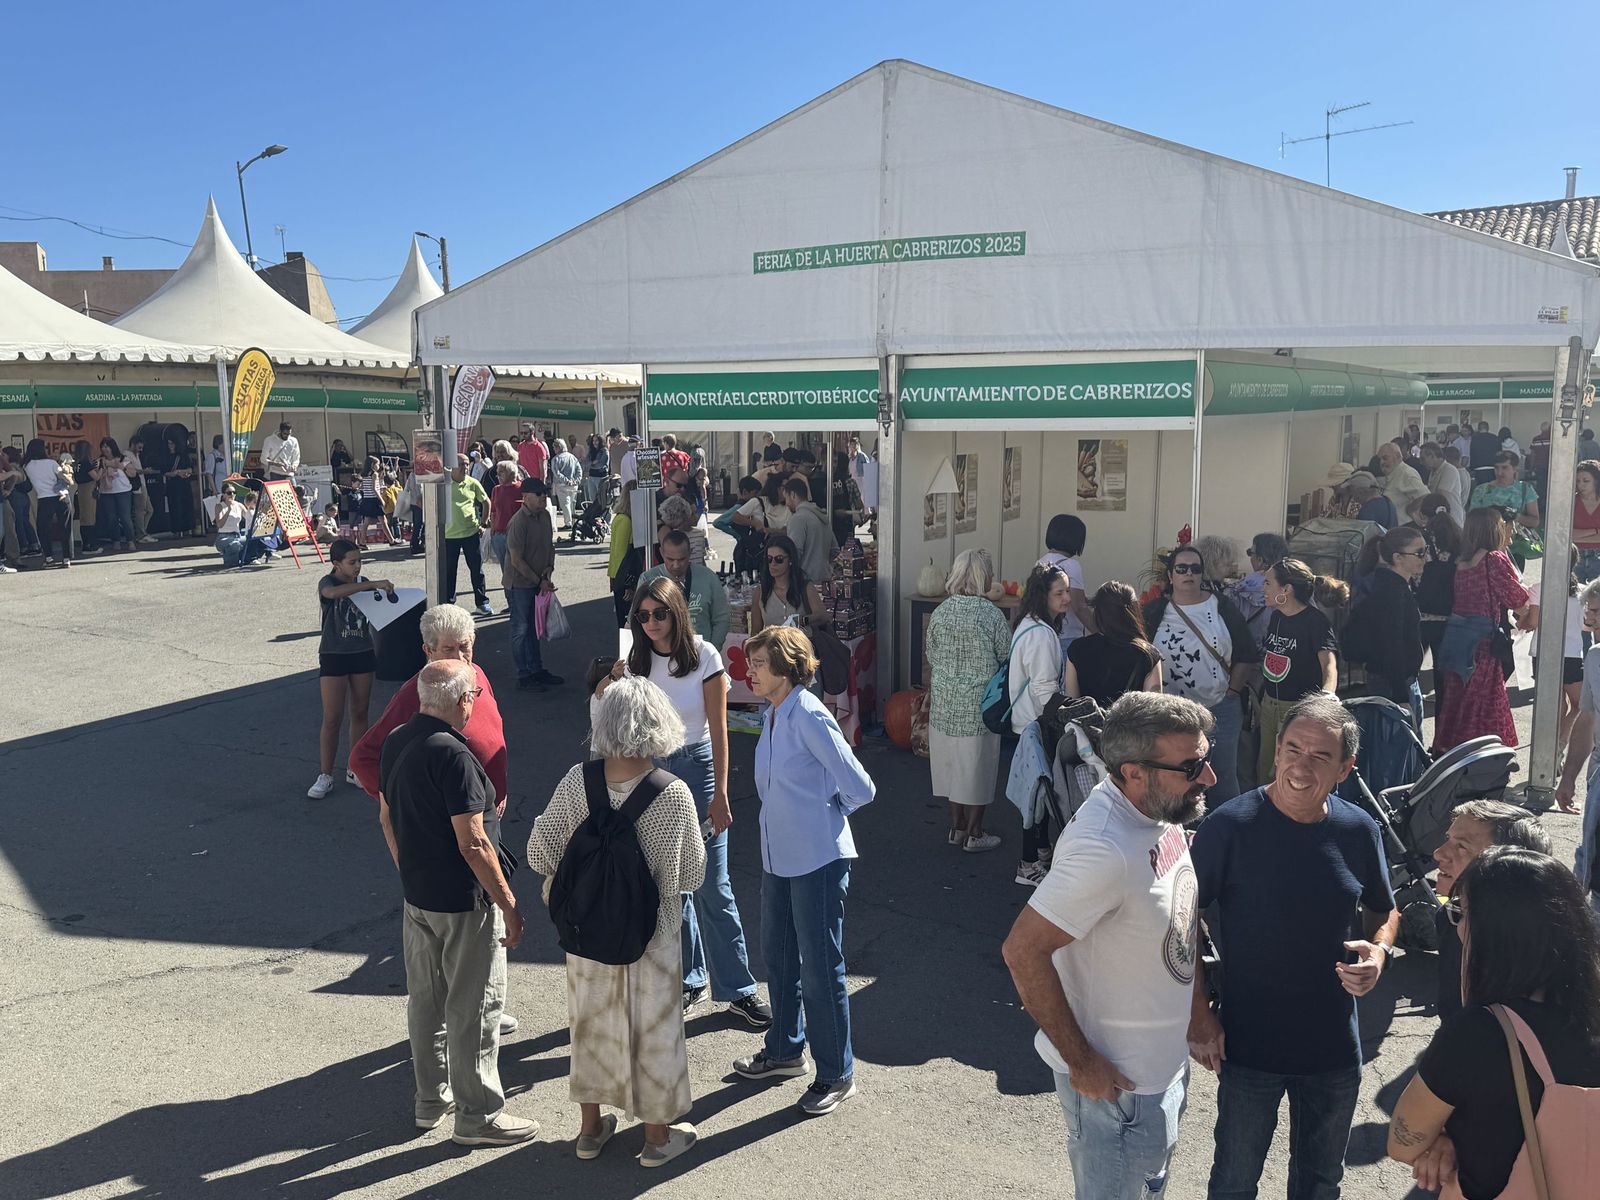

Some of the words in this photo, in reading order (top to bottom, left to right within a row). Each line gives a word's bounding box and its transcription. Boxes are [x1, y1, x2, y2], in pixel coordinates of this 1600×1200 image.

[757, 253, 792, 270] FERIA
[795, 251, 812, 267] DE
[815, 249, 832, 265] LA
[835, 244, 889, 263] HUERTA
[892, 238, 981, 258] CABRERIZOS
[985, 236, 1021, 253] 2025
[85, 393, 116, 401] ASADINA
[121, 393, 130, 401] LA
[131, 393, 163, 401] PATATADA
[233, 359, 259, 414] PATATAS
[1069, 382, 1193, 401] CABRERIZOS
